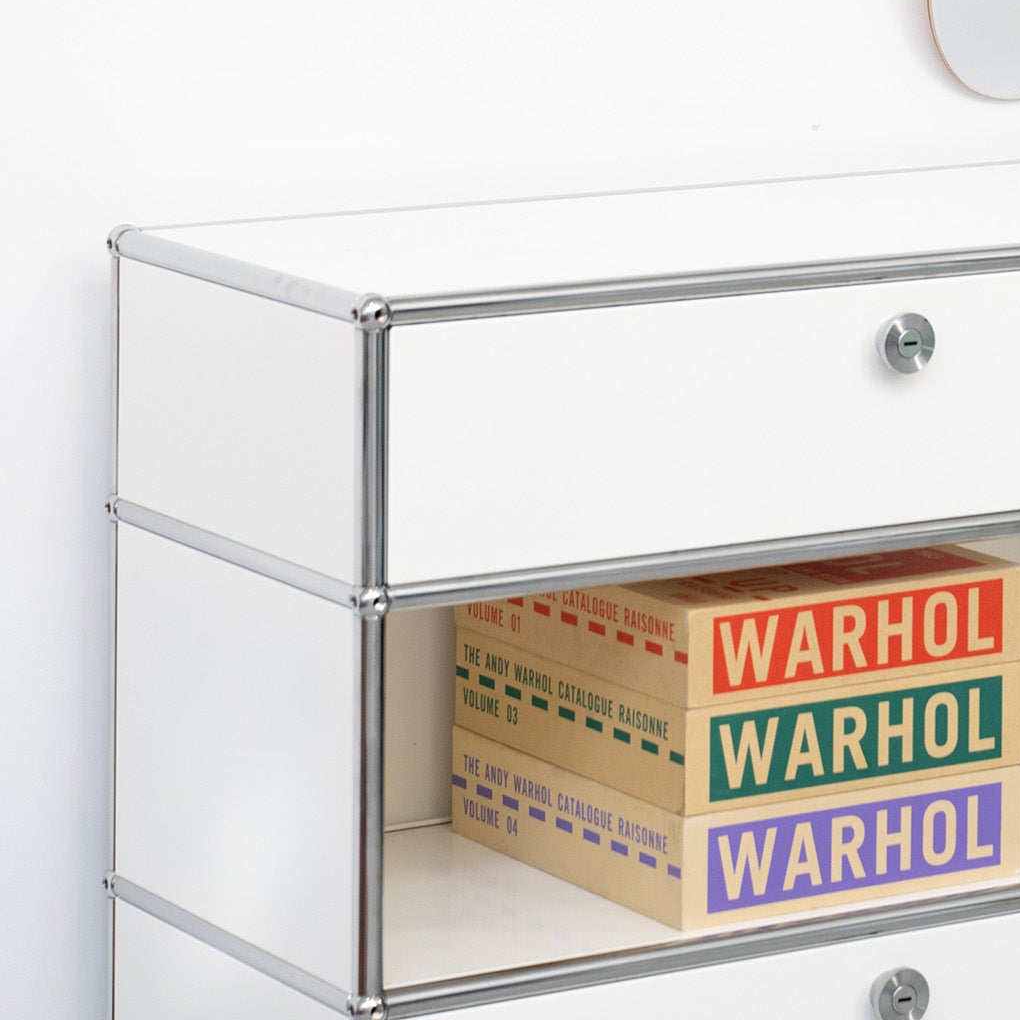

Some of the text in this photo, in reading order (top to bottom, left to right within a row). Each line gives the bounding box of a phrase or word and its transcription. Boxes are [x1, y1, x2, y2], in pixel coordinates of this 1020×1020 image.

[467, 602, 521, 633] VOLUME 01
[562, 590, 675, 642] CATALOGUE RAISONNE
[719, 587, 995, 687] WARHOL
[463, 688, 518, 726] VOLUME 03
[464, 643, 669, 741] THE ANDY WARHOL CATALOGUE RAISONNE
[718, 687, 996, 790] WARHOL
[463, 754, 668, 855] THE ANDY WARHOL CATALOGUE RAISONNE
[463, 797, 518, 837] VOLUME 04
[717, 794, 994, 900] WARHOL
